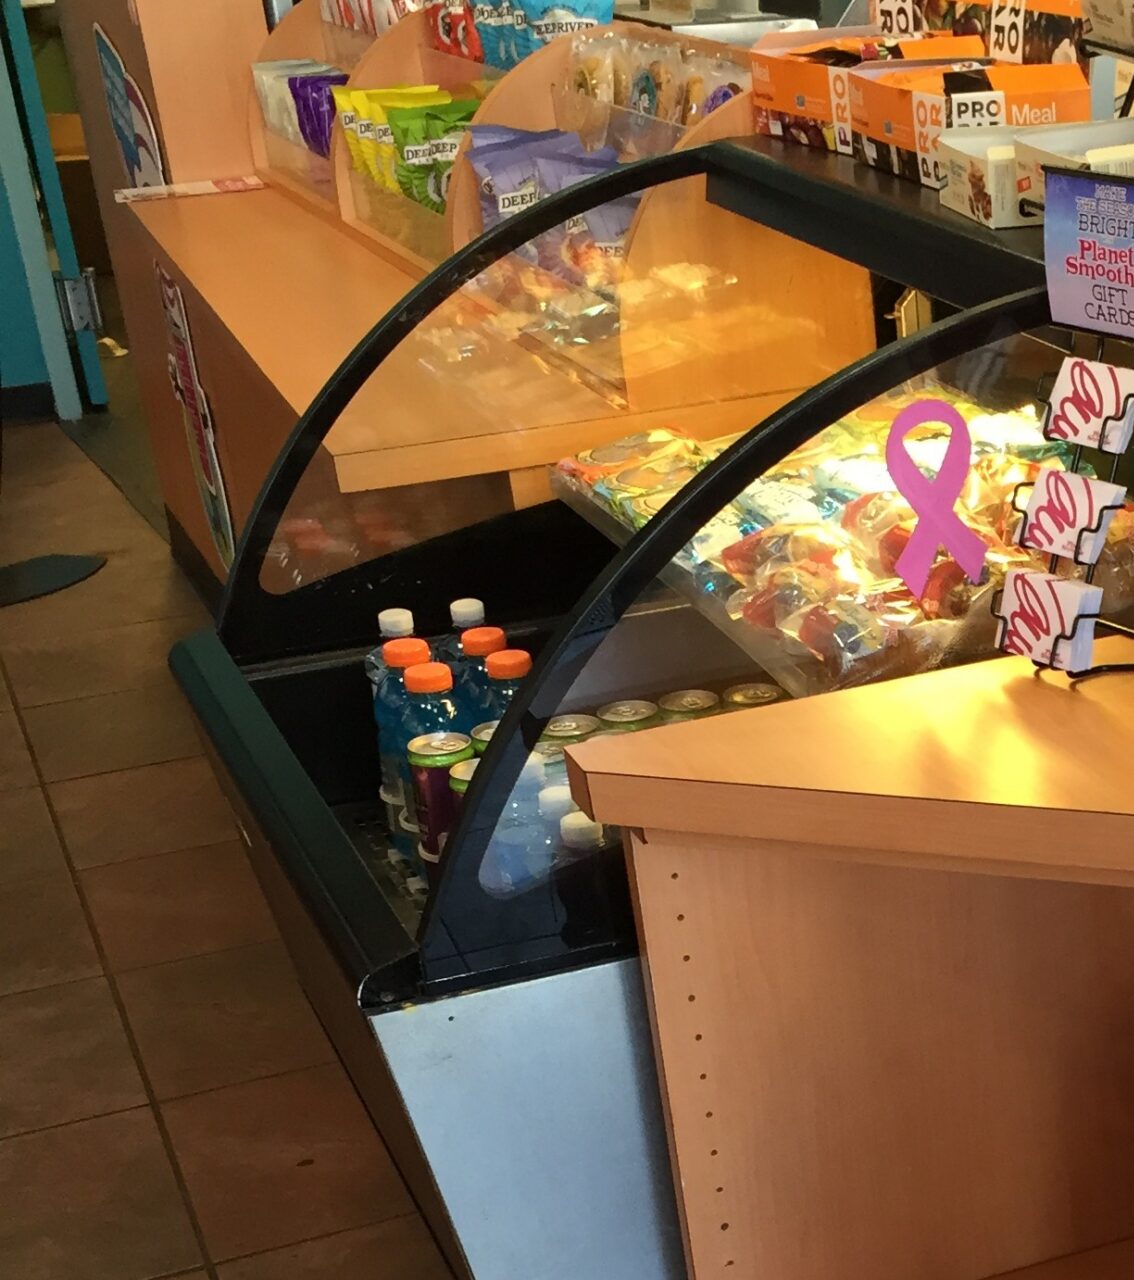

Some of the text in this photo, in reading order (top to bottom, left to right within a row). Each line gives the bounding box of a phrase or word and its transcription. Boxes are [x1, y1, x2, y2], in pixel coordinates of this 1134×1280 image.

[834, 73, 851, 148] PRO
[957, 100, 1057, 125] PRO Meal
[916, 100, 932, 179] PRO
[1075, 195, 1097, 213] THE
[1079, 239, 1134, 267] Planet
[1092, 284, 1128, 306] GIFT
